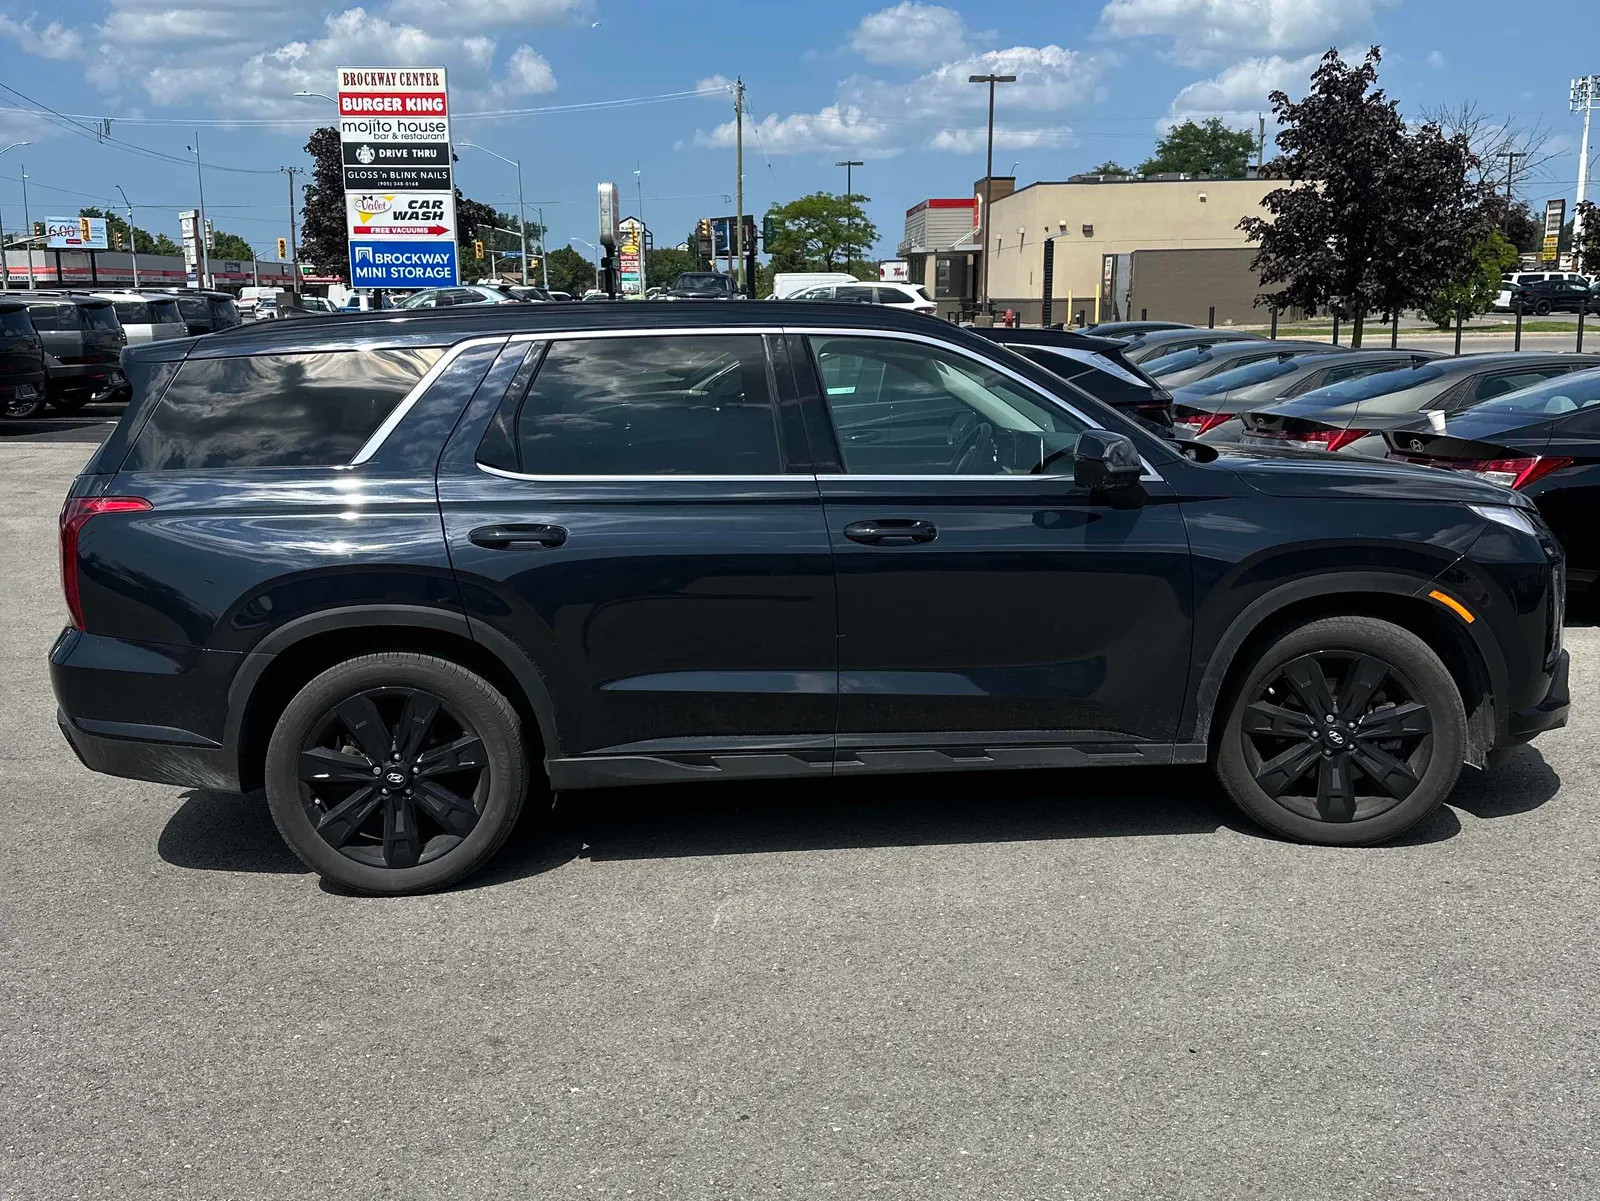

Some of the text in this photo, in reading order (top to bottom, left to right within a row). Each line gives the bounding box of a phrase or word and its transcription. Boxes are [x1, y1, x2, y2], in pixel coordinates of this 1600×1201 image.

[343, 72, 440, 86] BROCKWAY CENTER
[342, 97, 444, 112] BURGER KING
[398, 120, 446, 132] house
[378, 149, 437, 158] DRIVE THRU
[355, 200, 387, 210] Valet
[408, 200, 444, 210] CAR
[393, 211, 444, 220] WASH
[375, 254, 450, 264] BROCKWAY
[356, 266, 451, 278] MINI STORAGE
